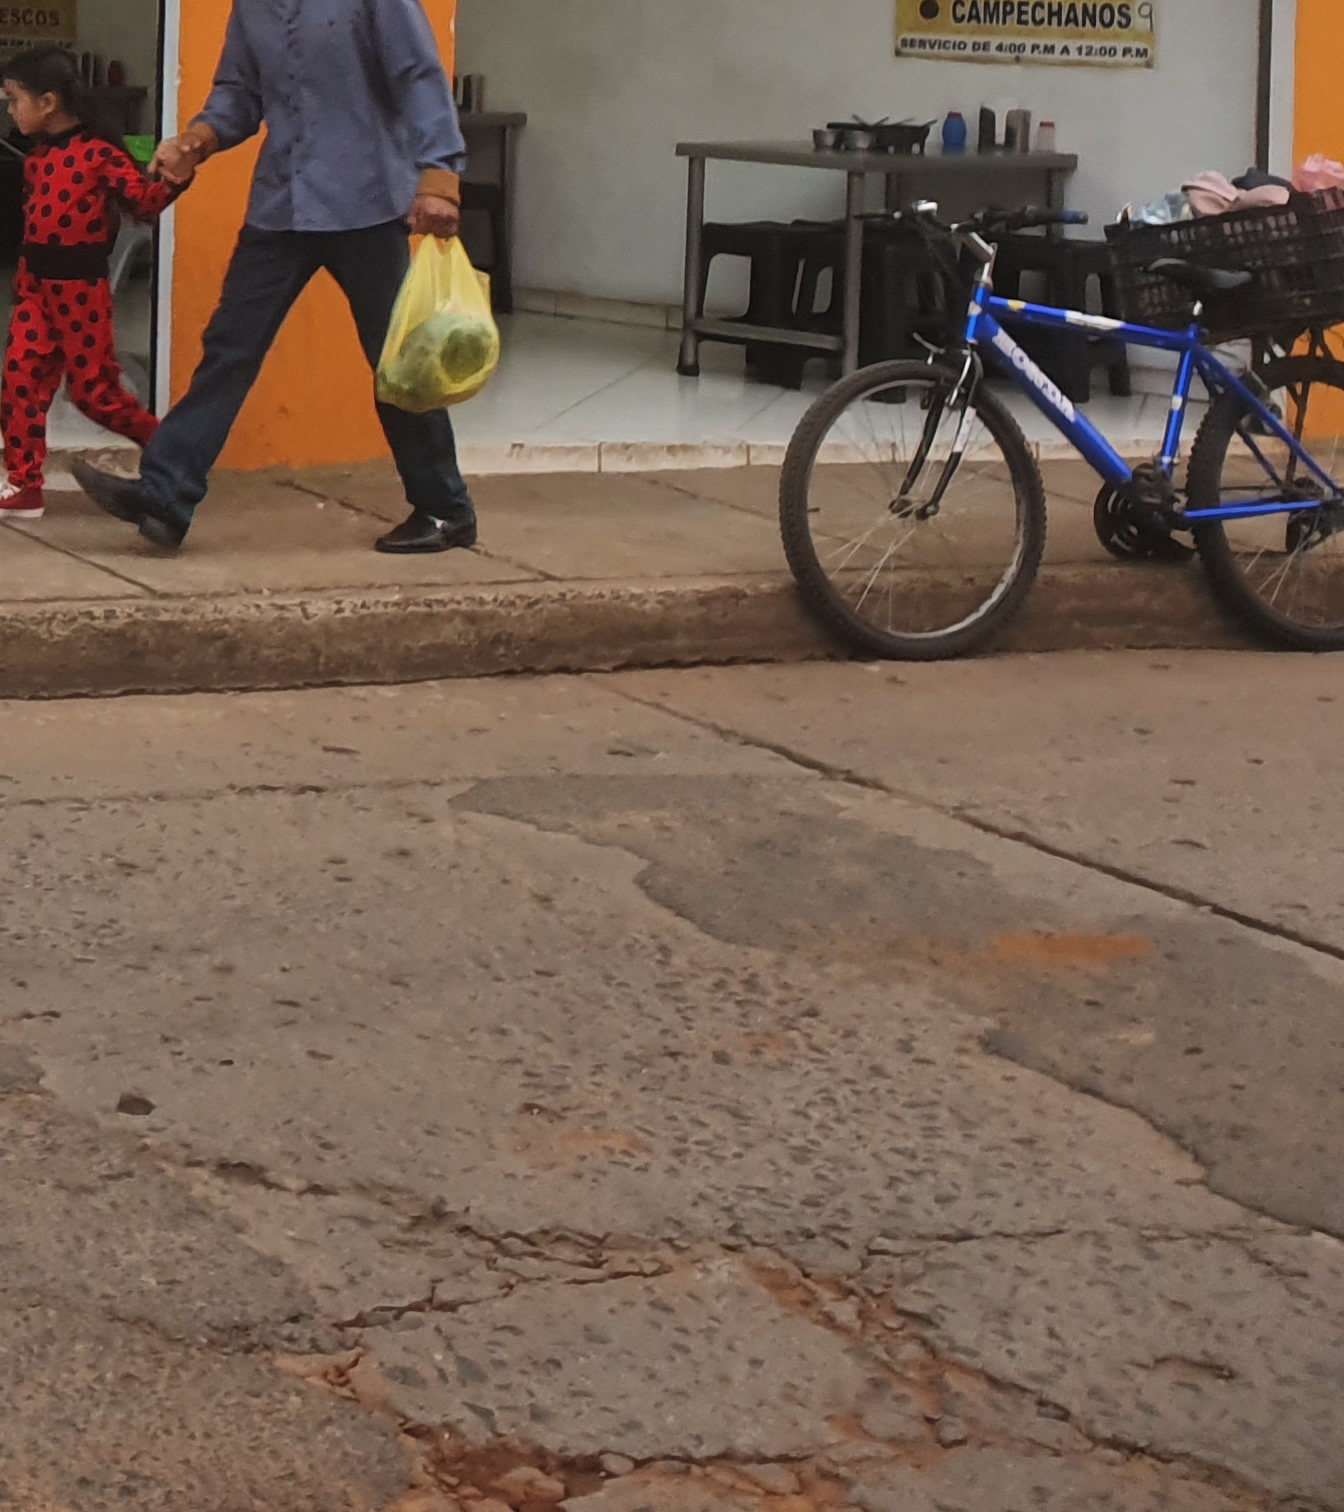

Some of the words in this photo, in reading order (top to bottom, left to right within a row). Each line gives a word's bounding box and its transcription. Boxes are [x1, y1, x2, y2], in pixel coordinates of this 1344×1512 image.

[952, 0, 1131, 29] CAMPECHANOS
[1138, 2, 1154, 31] 9
[900, 38, 966, 51] SERVICIO
[972, 40, 990, 52] DE
[995, 41, 1026, 55] 4:00
[1031, 43, 1055, 55] P.M
[1059, 44, 1071, 56] A
[1076, 45, 1117, 58] 12:00
[1121, 47, 1148, 59] P.M
